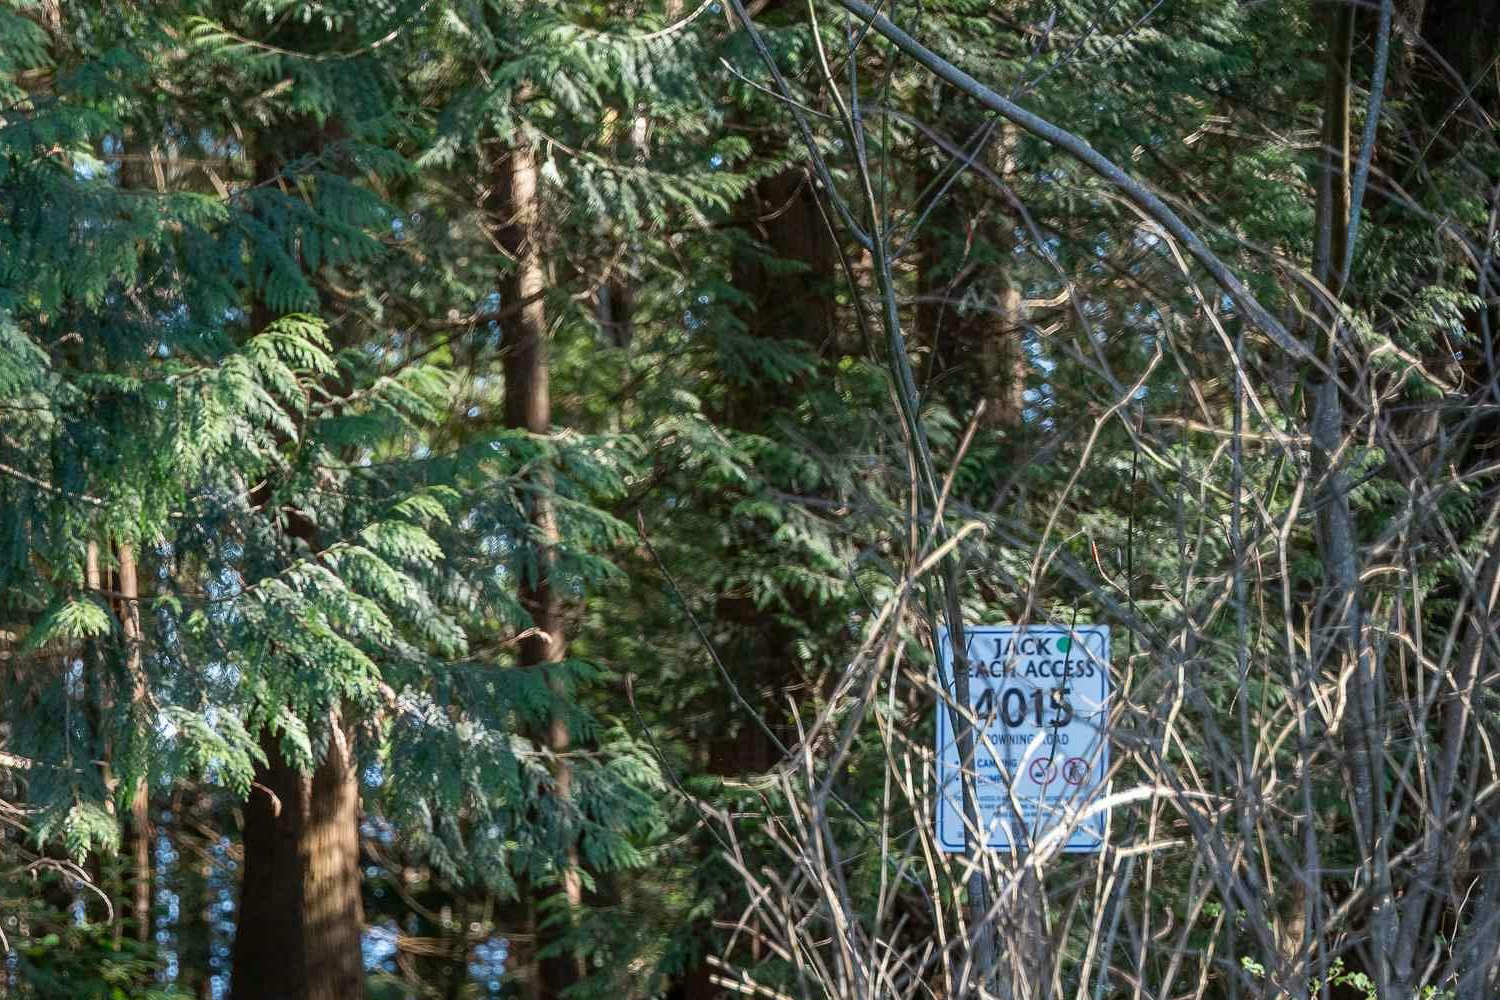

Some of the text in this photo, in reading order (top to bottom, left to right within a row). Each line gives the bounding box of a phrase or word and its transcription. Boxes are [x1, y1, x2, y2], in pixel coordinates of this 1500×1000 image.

[993, 637, 1052, 659] JACK
[1025, 660, 1095, 678] ACCESS
[974, 687, 1074, 728] 4015
[1040, 734, 1069, 745] OAD
